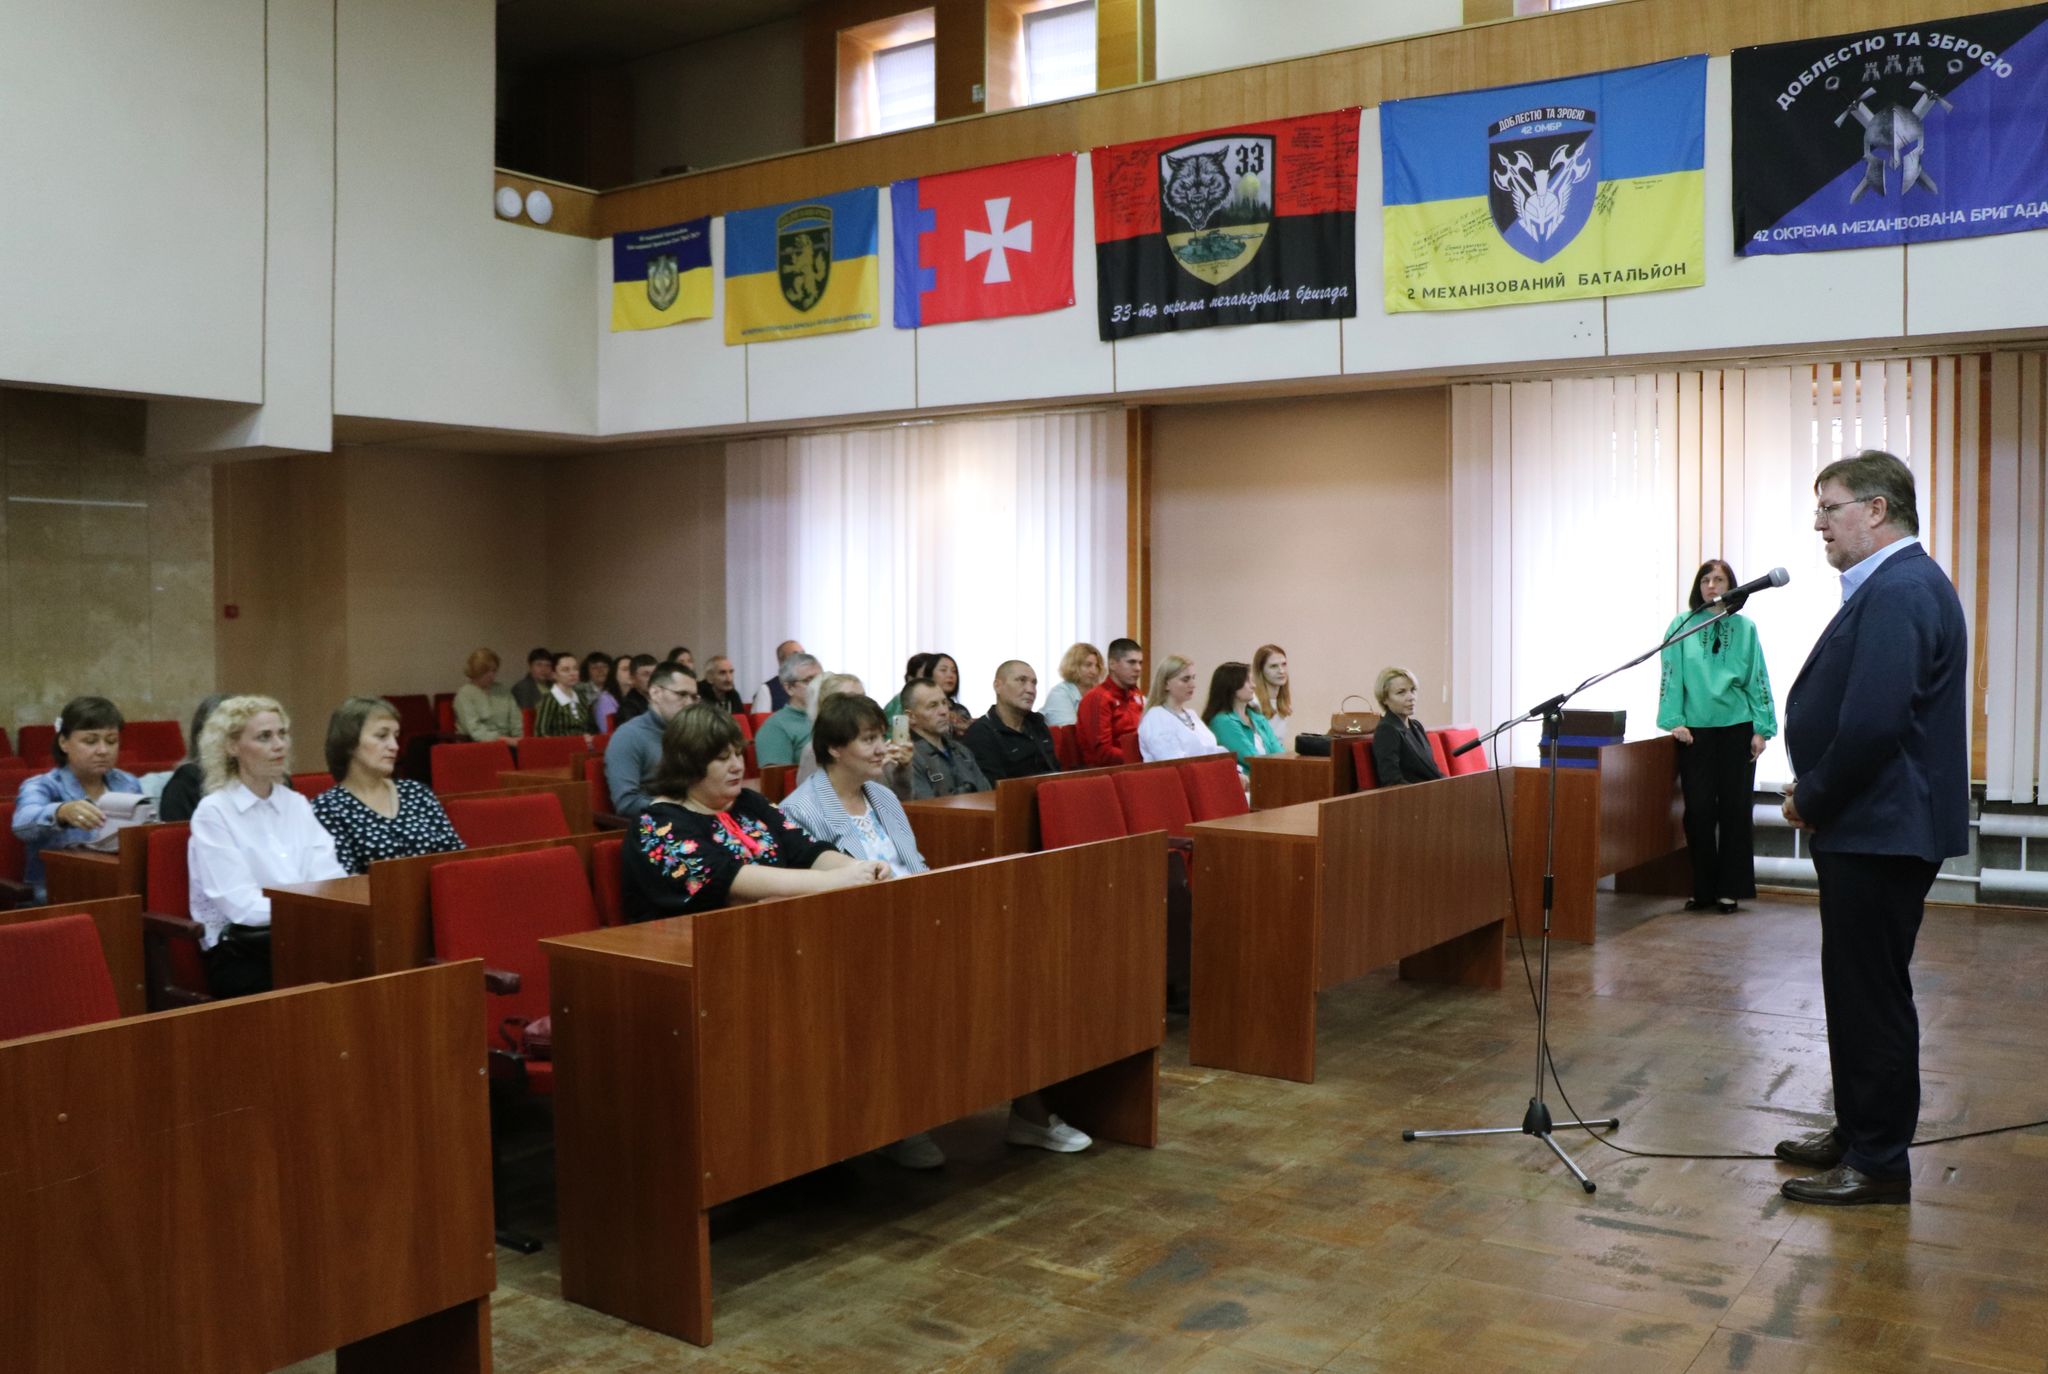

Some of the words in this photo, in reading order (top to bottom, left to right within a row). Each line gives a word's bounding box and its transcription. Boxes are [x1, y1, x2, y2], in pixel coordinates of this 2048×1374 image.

[1776, 35, 1885, 111] ДОБЛЕСТЮ
[1893, 31, 1921, 48] ТА
[1927, 33, 2013, 79] ЗБРОЄЮ
[1498, 109, 1543, 132] ДОБЛЕСТЮ
[1546, 108, 1556, 119] ТА
[1521, 125, 1533, 135] 42
[1534, 122, 1562, 132] ОМБР
[1235, 142, 1264, 177] 33
[1753, 230, 1770, 242] 42
[1773, 223, 1838, 241] ОКРЕМА
[1970, 201, 2048, 223] БРИГАДА
[1408, 289, 1415, 300] 2
[1422, 272, 1566, 299] МЕХАНІЗОВАНИЙ
[1579, 262, 1687, 286] БАТАЛЬЙОН
[1111, 304, 1158, 322] 33-тя
[1163, 299, 1205, 317] окрема
[1209, 285, 1290, 311] механізована
[1296, 285, 1350, 305] бригада
